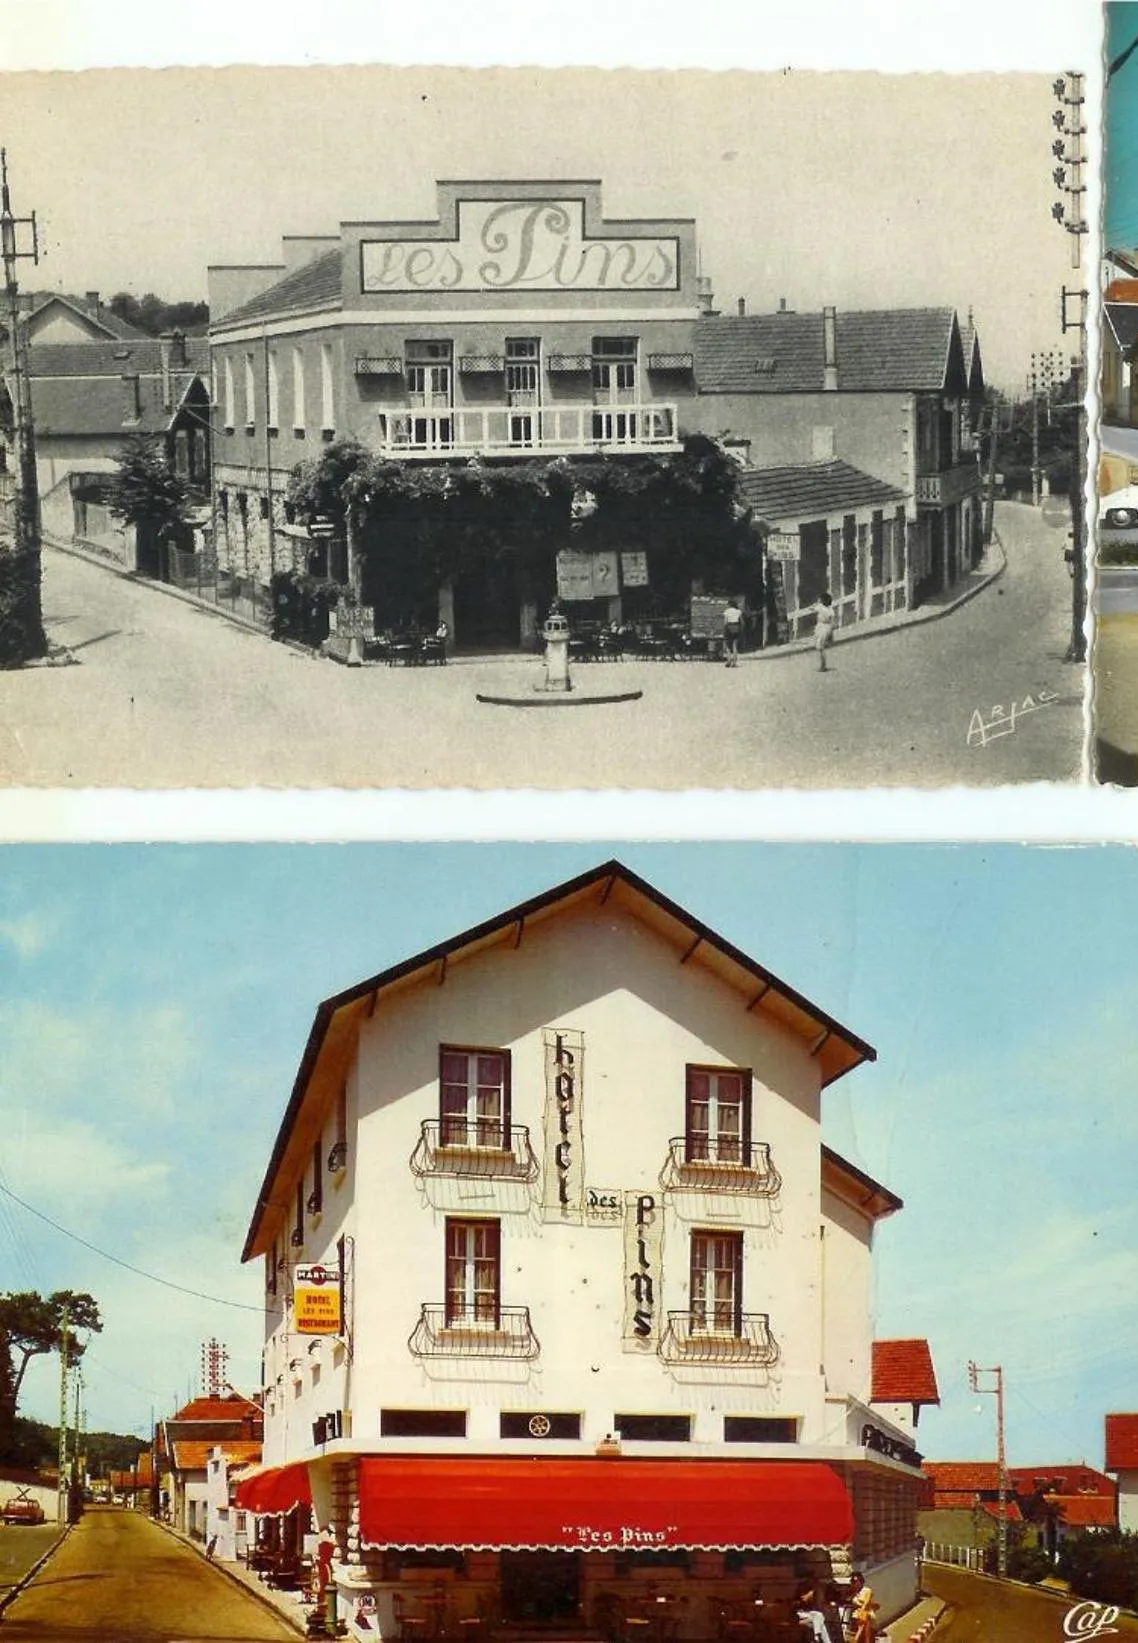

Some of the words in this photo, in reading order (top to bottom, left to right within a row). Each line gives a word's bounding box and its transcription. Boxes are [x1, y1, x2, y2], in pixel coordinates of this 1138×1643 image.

[366, 243, 463, 287] Les
[478, 200, 672, 287] Pins
[589, 1189, 618, 1208] des
